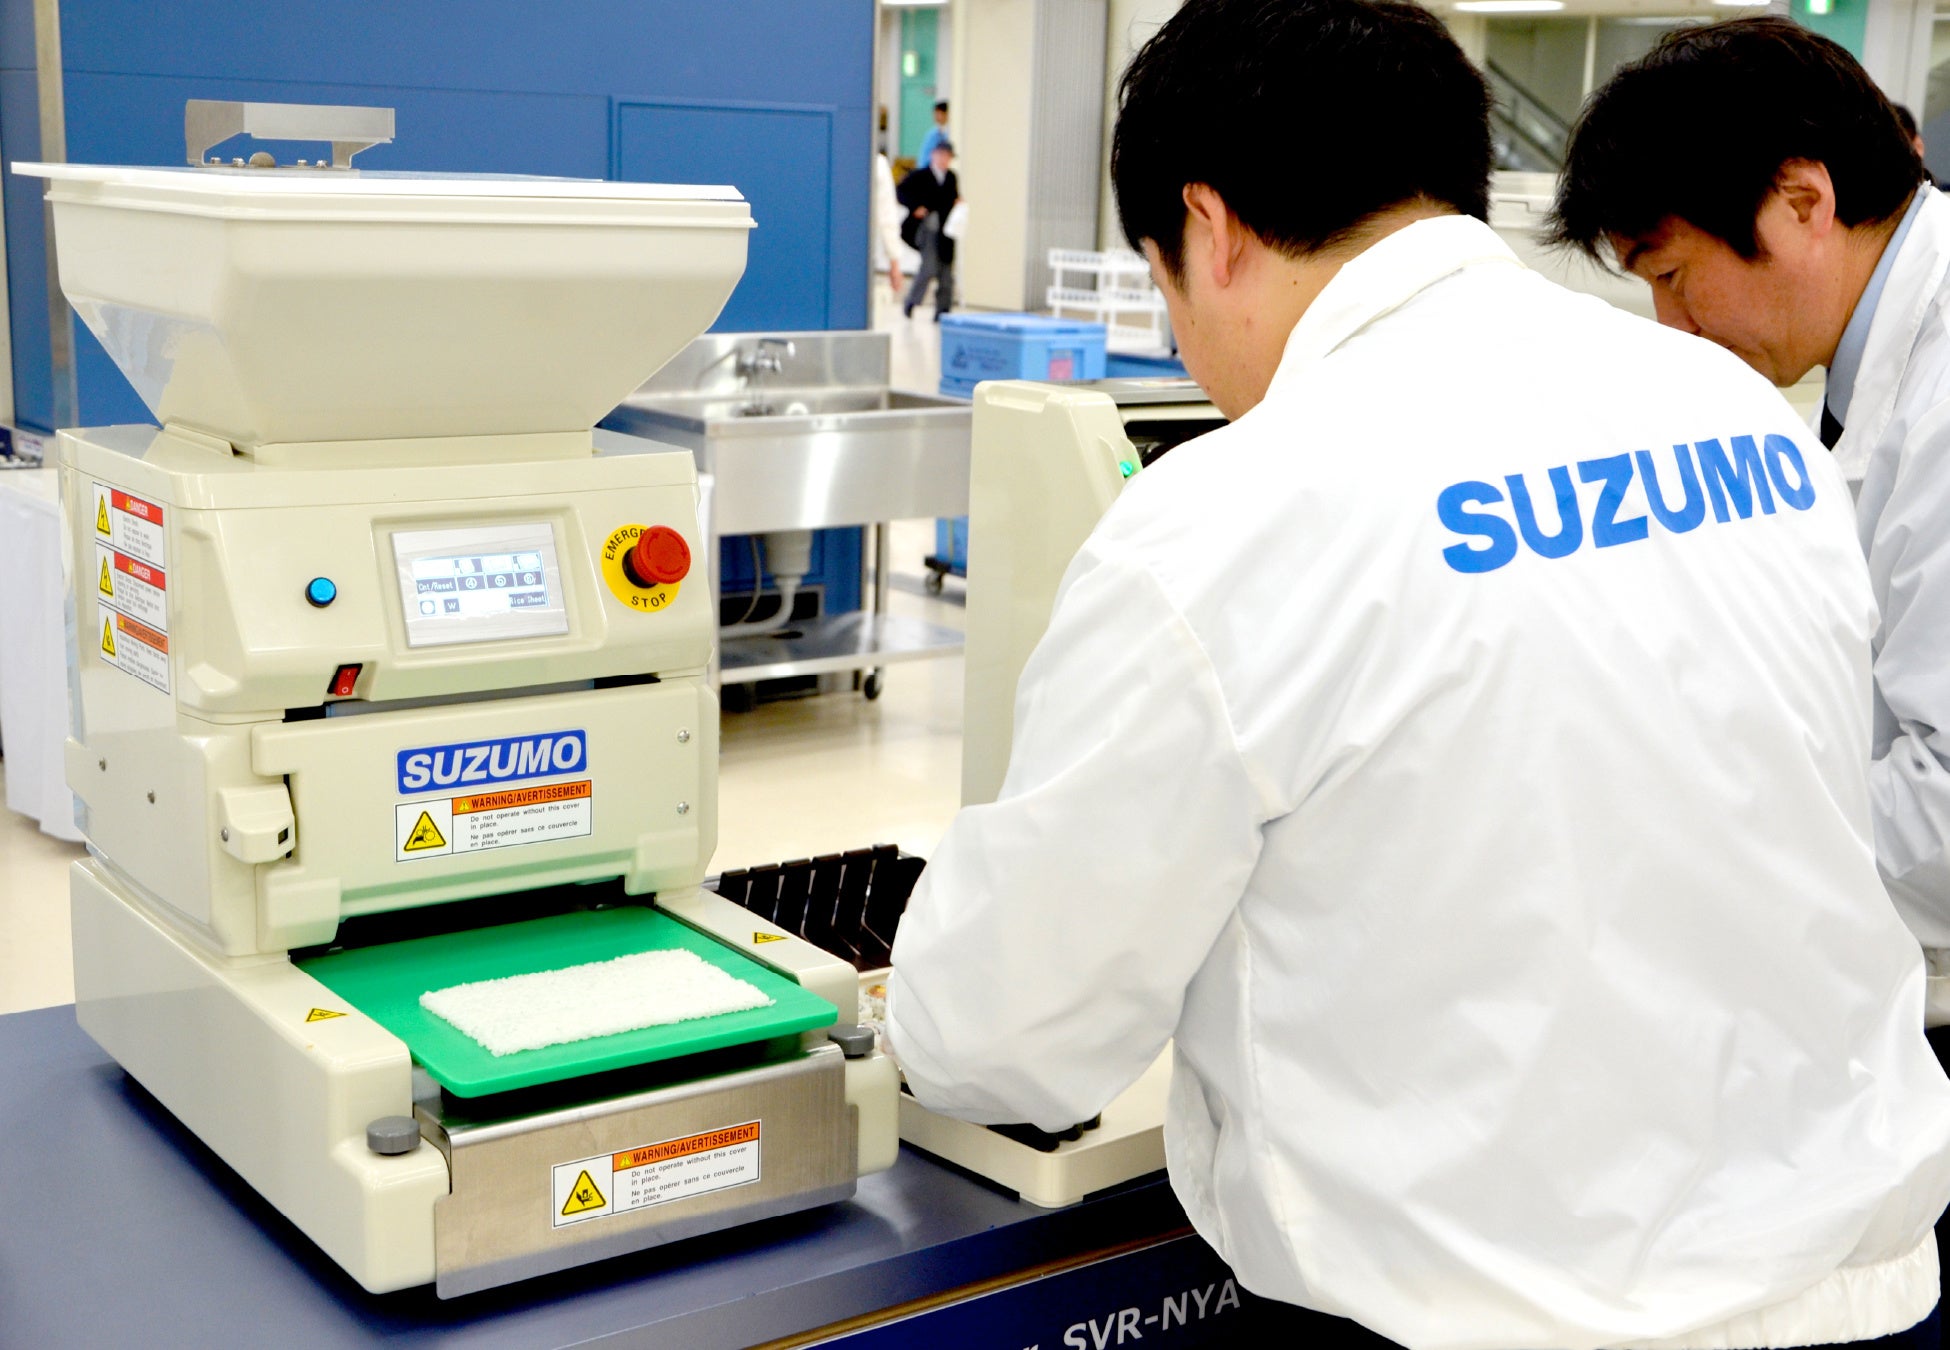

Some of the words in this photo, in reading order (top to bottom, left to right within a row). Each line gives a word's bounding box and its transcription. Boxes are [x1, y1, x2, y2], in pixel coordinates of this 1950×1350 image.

[1437, 433, 1817, 573] SUZUMO
[631, 593, 666, 608] STOP
[403, 735, 582, 789] SUZUMO
[470, 815, 480, 823] Do
[496, 810, 520, 820] operate
[523, 807, 545, 815] without
[562, 802, 580, 810] cover
[471, 784, 587, 809] WARNING/AVERTISSEMENT
[482, 832, 494, 840] pas
[520, 826, 535, 834] sans
[547, 820, 578, 830] couvercle
[633, 1126, 754, 1163] WARNING/AVERTISSEMENT
[631, 1170, 641, 1178] Do
[644, 1167, 656, 1175] not
[658, 1161, 684, 1172] operate
[687, 1154, 711, 1165] without
[713, 1151, 726, 1159] this
[729, 1146, 748, 1156] cover
[631, 1190, 641, 1198] Ne
[643, 1187, 656, 1195] pas
[684, 1175, 700, 1185] sans
[713, 1165, 745, 1178] couvercle
[631, 1178, 638, 1186] in
[1063, 1278, 1241, 1350] SVR-NYA
